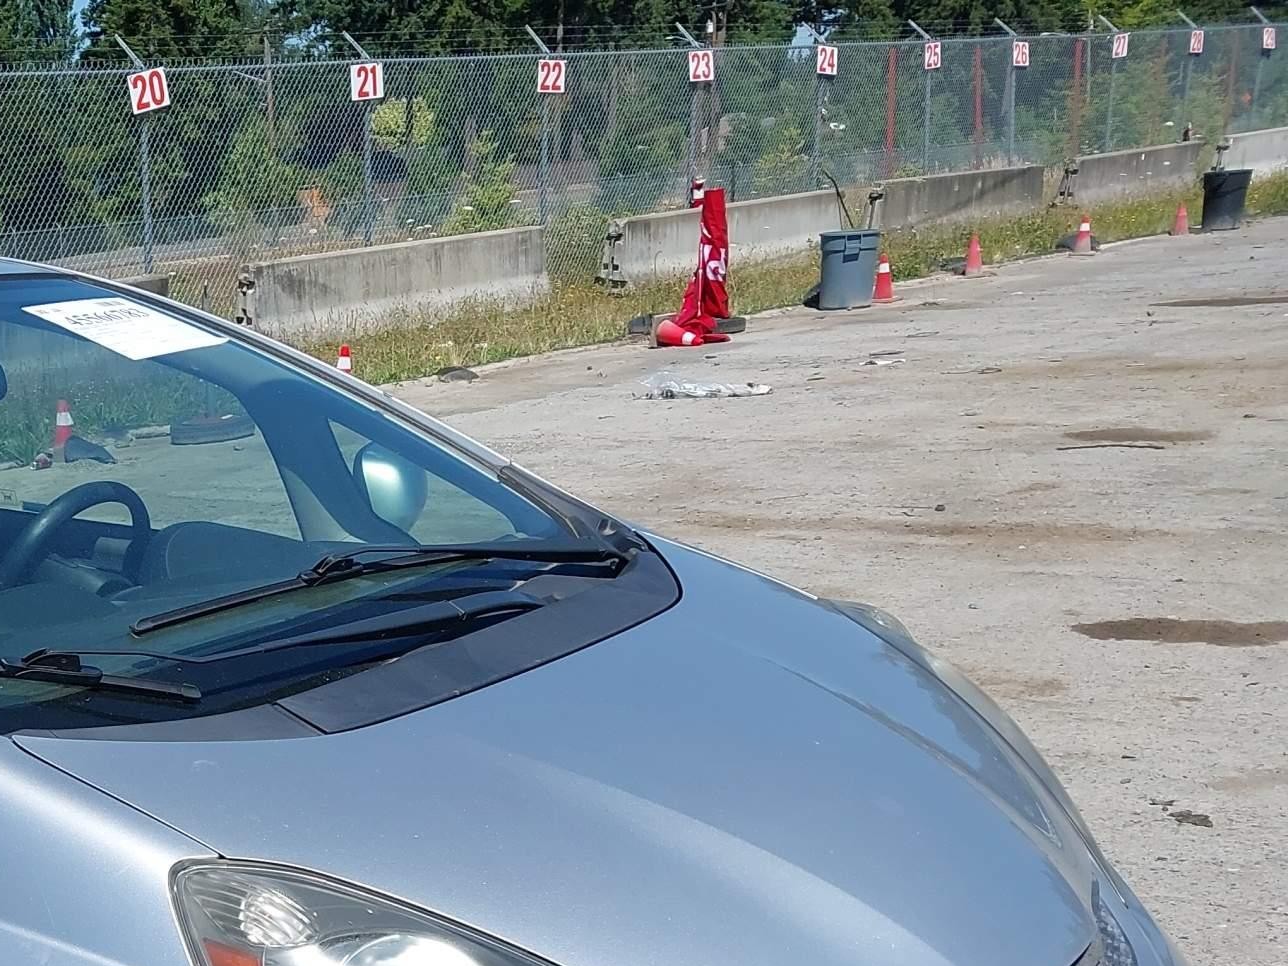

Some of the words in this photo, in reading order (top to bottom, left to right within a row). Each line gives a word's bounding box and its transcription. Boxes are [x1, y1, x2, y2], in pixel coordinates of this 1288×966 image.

[1014, 43, 1028, 65] 26
[1114, 36, 1127, 57] 27
[1191, 31, 1203, 52] 28
[691, 52, 711, 80] 23
[819, 47, 836, 73] 24
[926, 44, 940, 68] 25
[356, 65, 378, 98] 21
[540, 61, 562, 91] 22
[132, 71, 165, 110] 20
